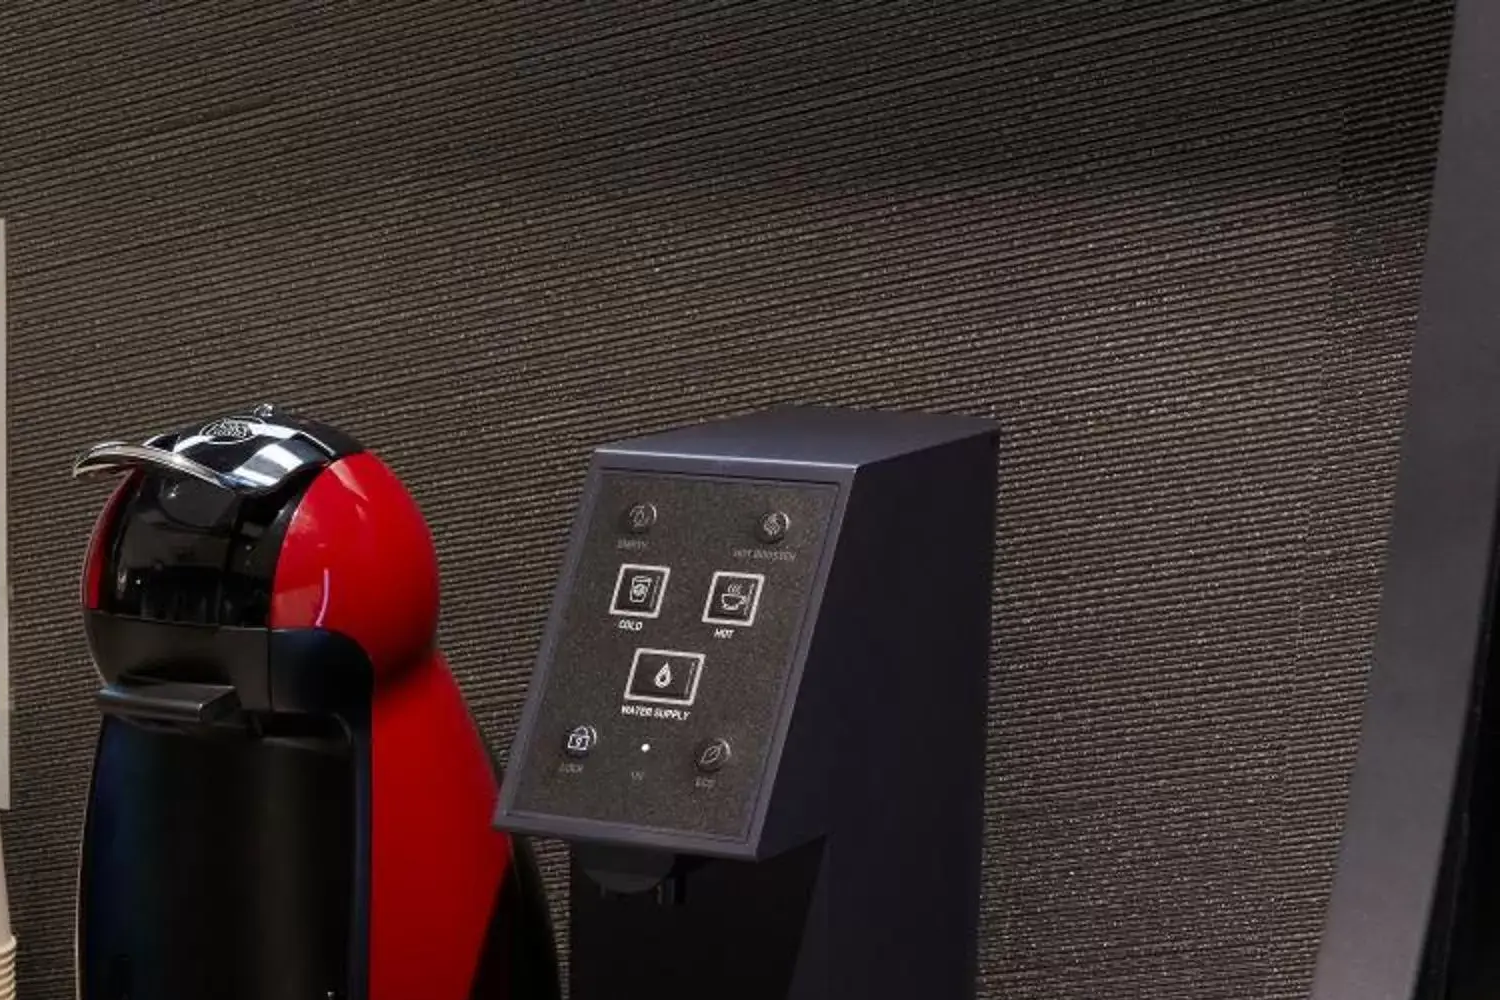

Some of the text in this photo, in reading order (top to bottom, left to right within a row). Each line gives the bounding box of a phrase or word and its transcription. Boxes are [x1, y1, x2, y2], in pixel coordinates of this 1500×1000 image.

[618, 620, 643, 632] COLD
[714, 628, 735, 640] HOT
[622, 705, 691, 721] WATER SUPPLY
